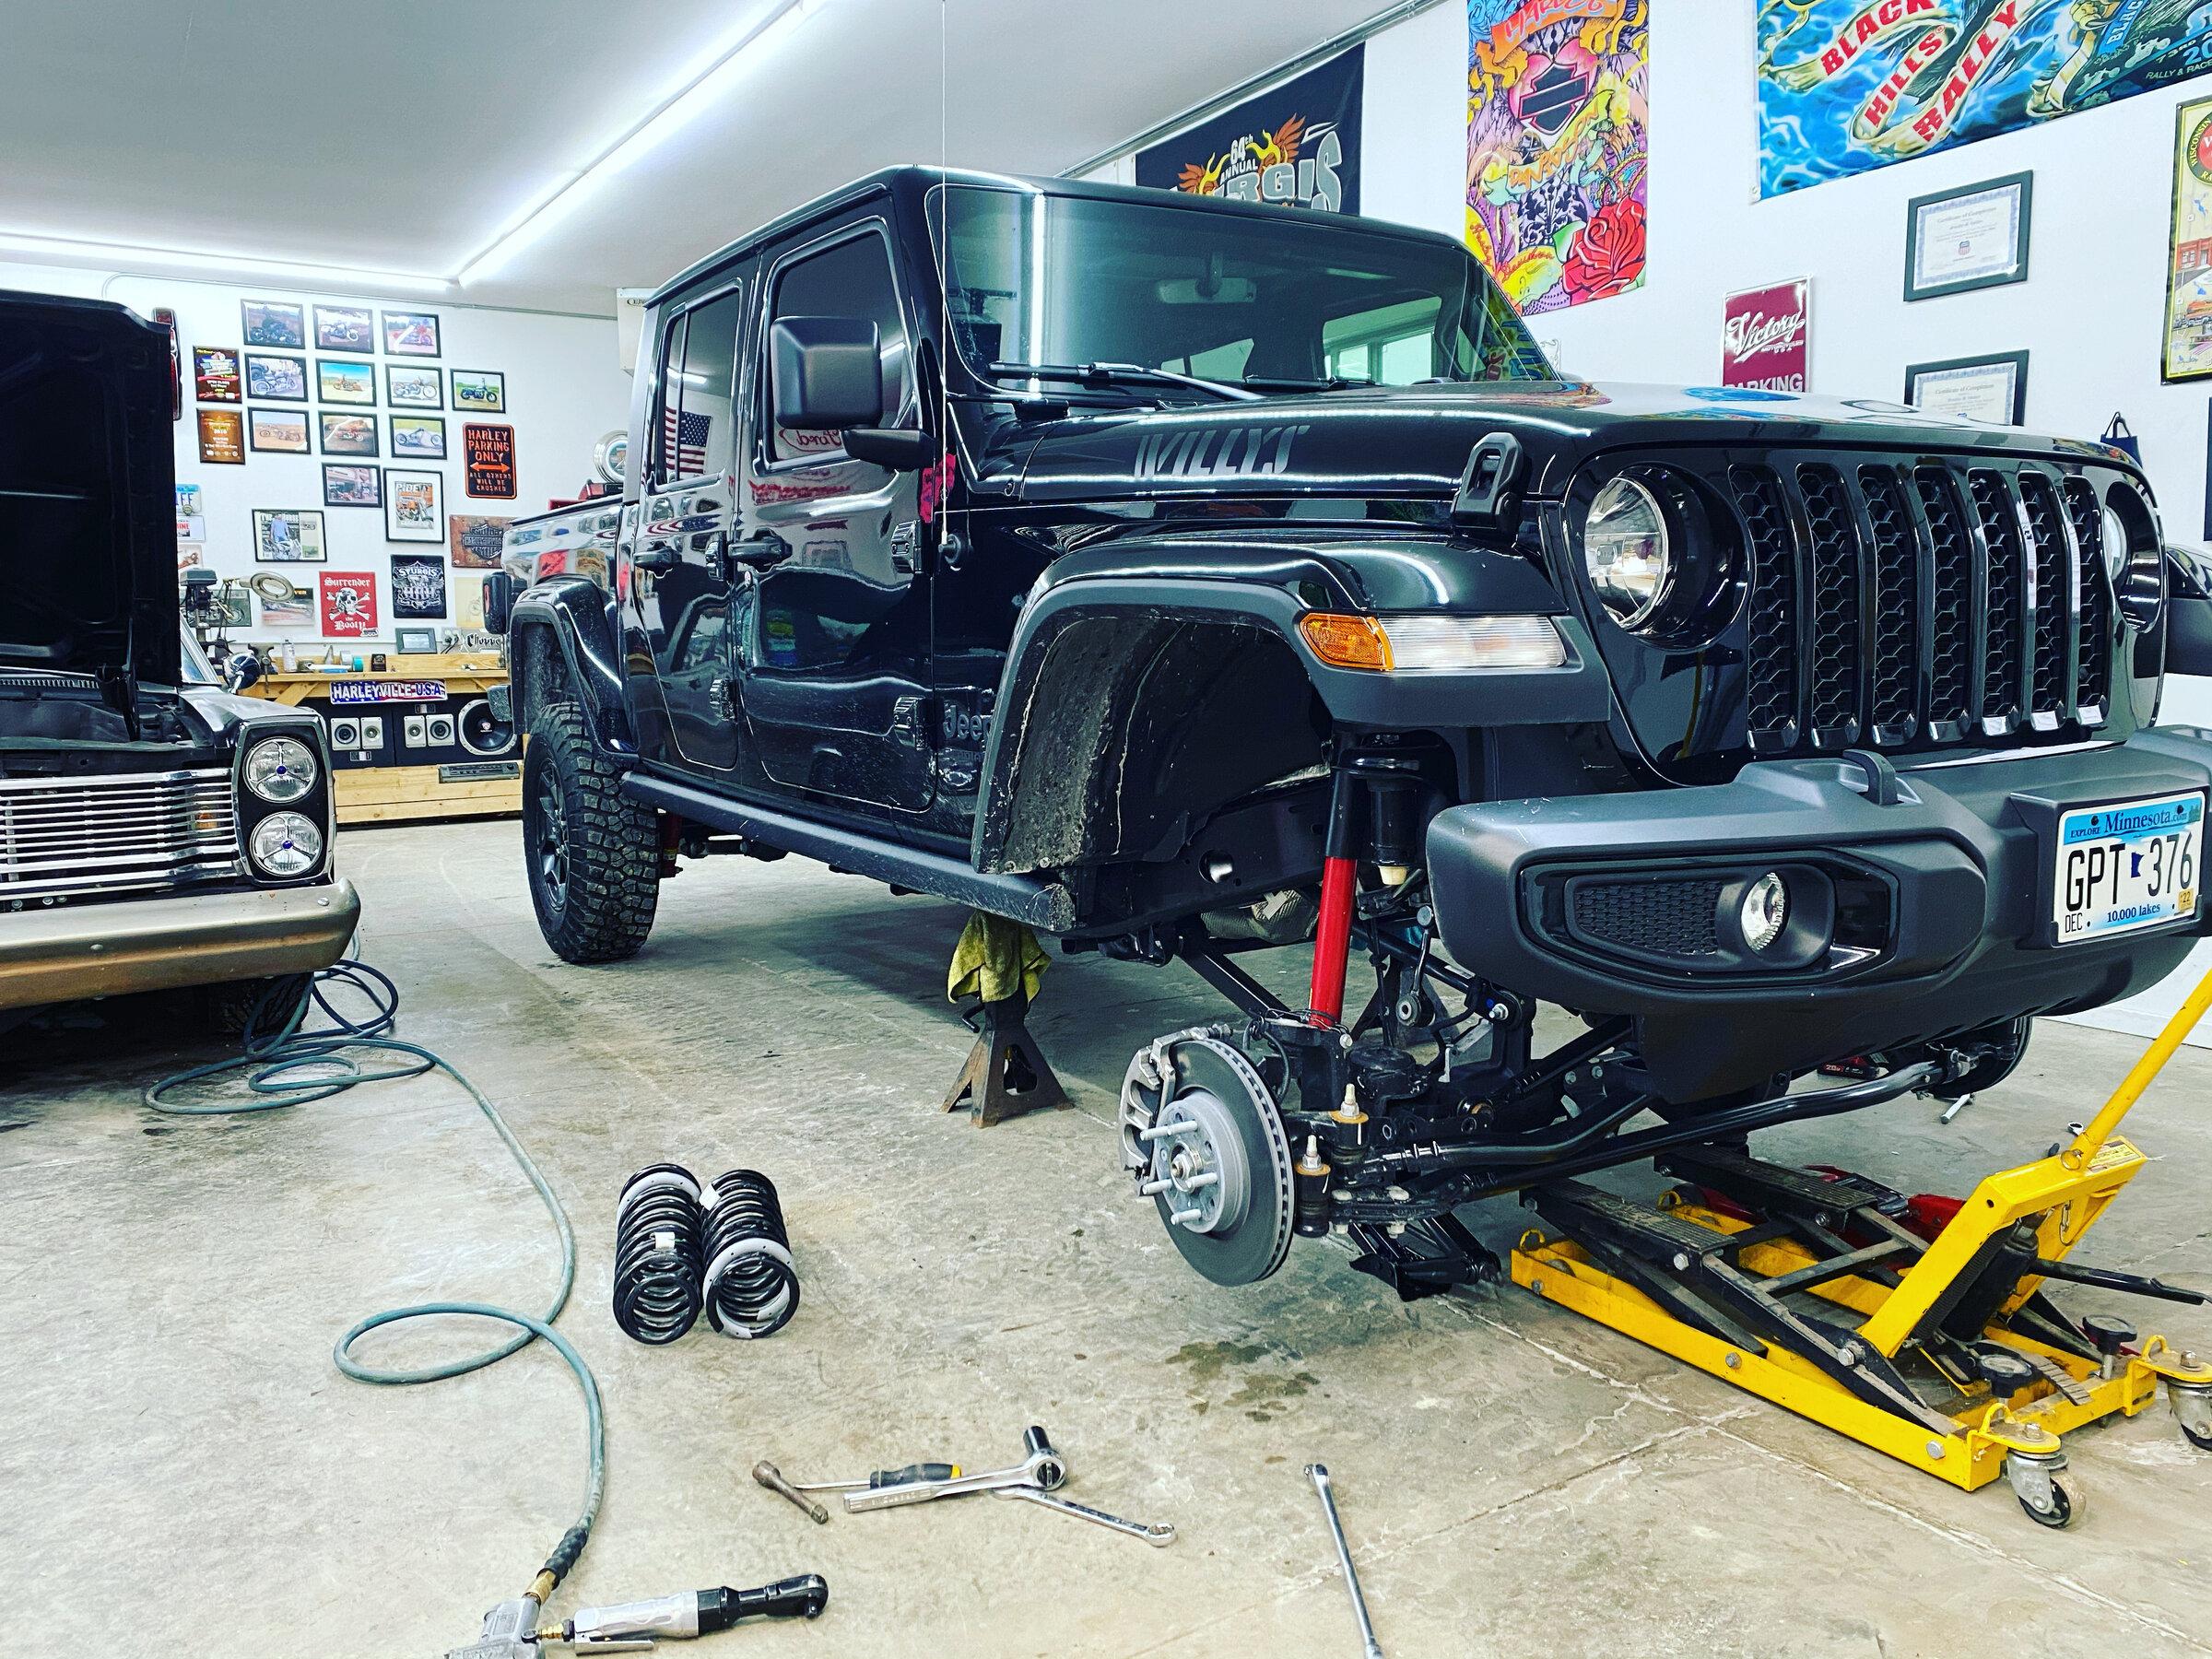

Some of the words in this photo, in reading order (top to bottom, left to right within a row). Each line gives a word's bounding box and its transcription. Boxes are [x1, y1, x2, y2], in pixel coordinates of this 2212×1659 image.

[1912, 1, 2020, 143] RALLY
[2146, 69, 2177, 80] RALLY
[1230, 134, 1254, 164] 64th
[1219, 157, 1259, 185] ANNUAL
[1725, 312, 1806, 358] Victory
[468, 429, 508, 441] HARLEY
[467, 440, 511, 452] PARKING
[475, 451, 505, 463] ONLY
[324, 576, 371, 587] Surrender
[333, 684, 412, 699] HARLEYVILLE
[2070, 826, 2101, 839] EXPLORE
[2065, 842, 2125, 912] GPT
[2147, 831, 2194, 898] 376
[2138, 903, 2161, 917] lakes
[2065, 912, 2084, 933] DEC
